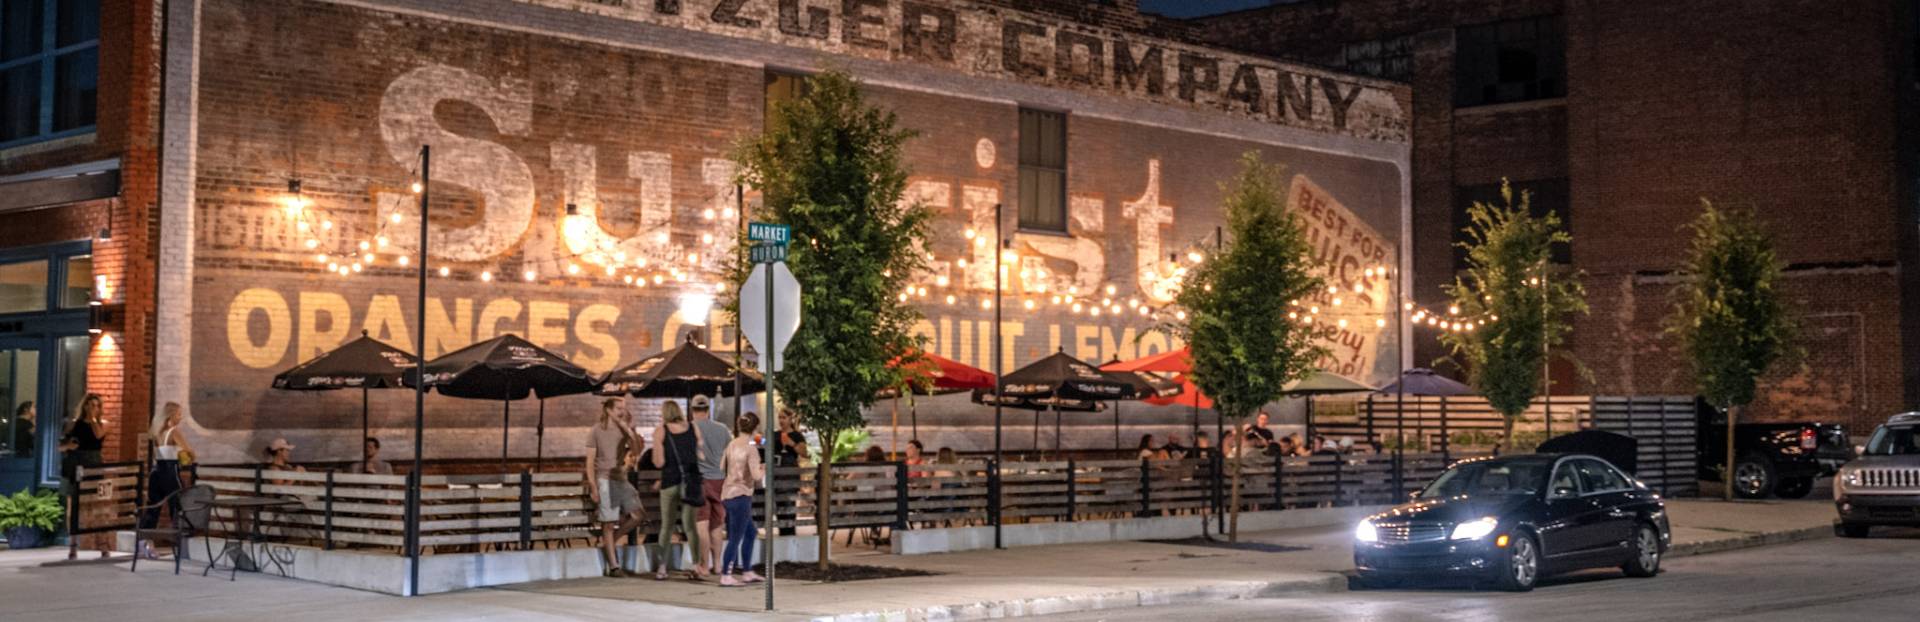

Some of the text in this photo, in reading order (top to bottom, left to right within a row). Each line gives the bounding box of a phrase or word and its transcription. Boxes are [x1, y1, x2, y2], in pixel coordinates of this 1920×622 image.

[1002, 20, 1365, 128] COMPANY
[751, 224, 786, 241] MARKET
[752, 245, 784, 261] HURON
[1299, 185, 1385, 263] BEST FOR
[227, 288, 620, 380] ORANGES
